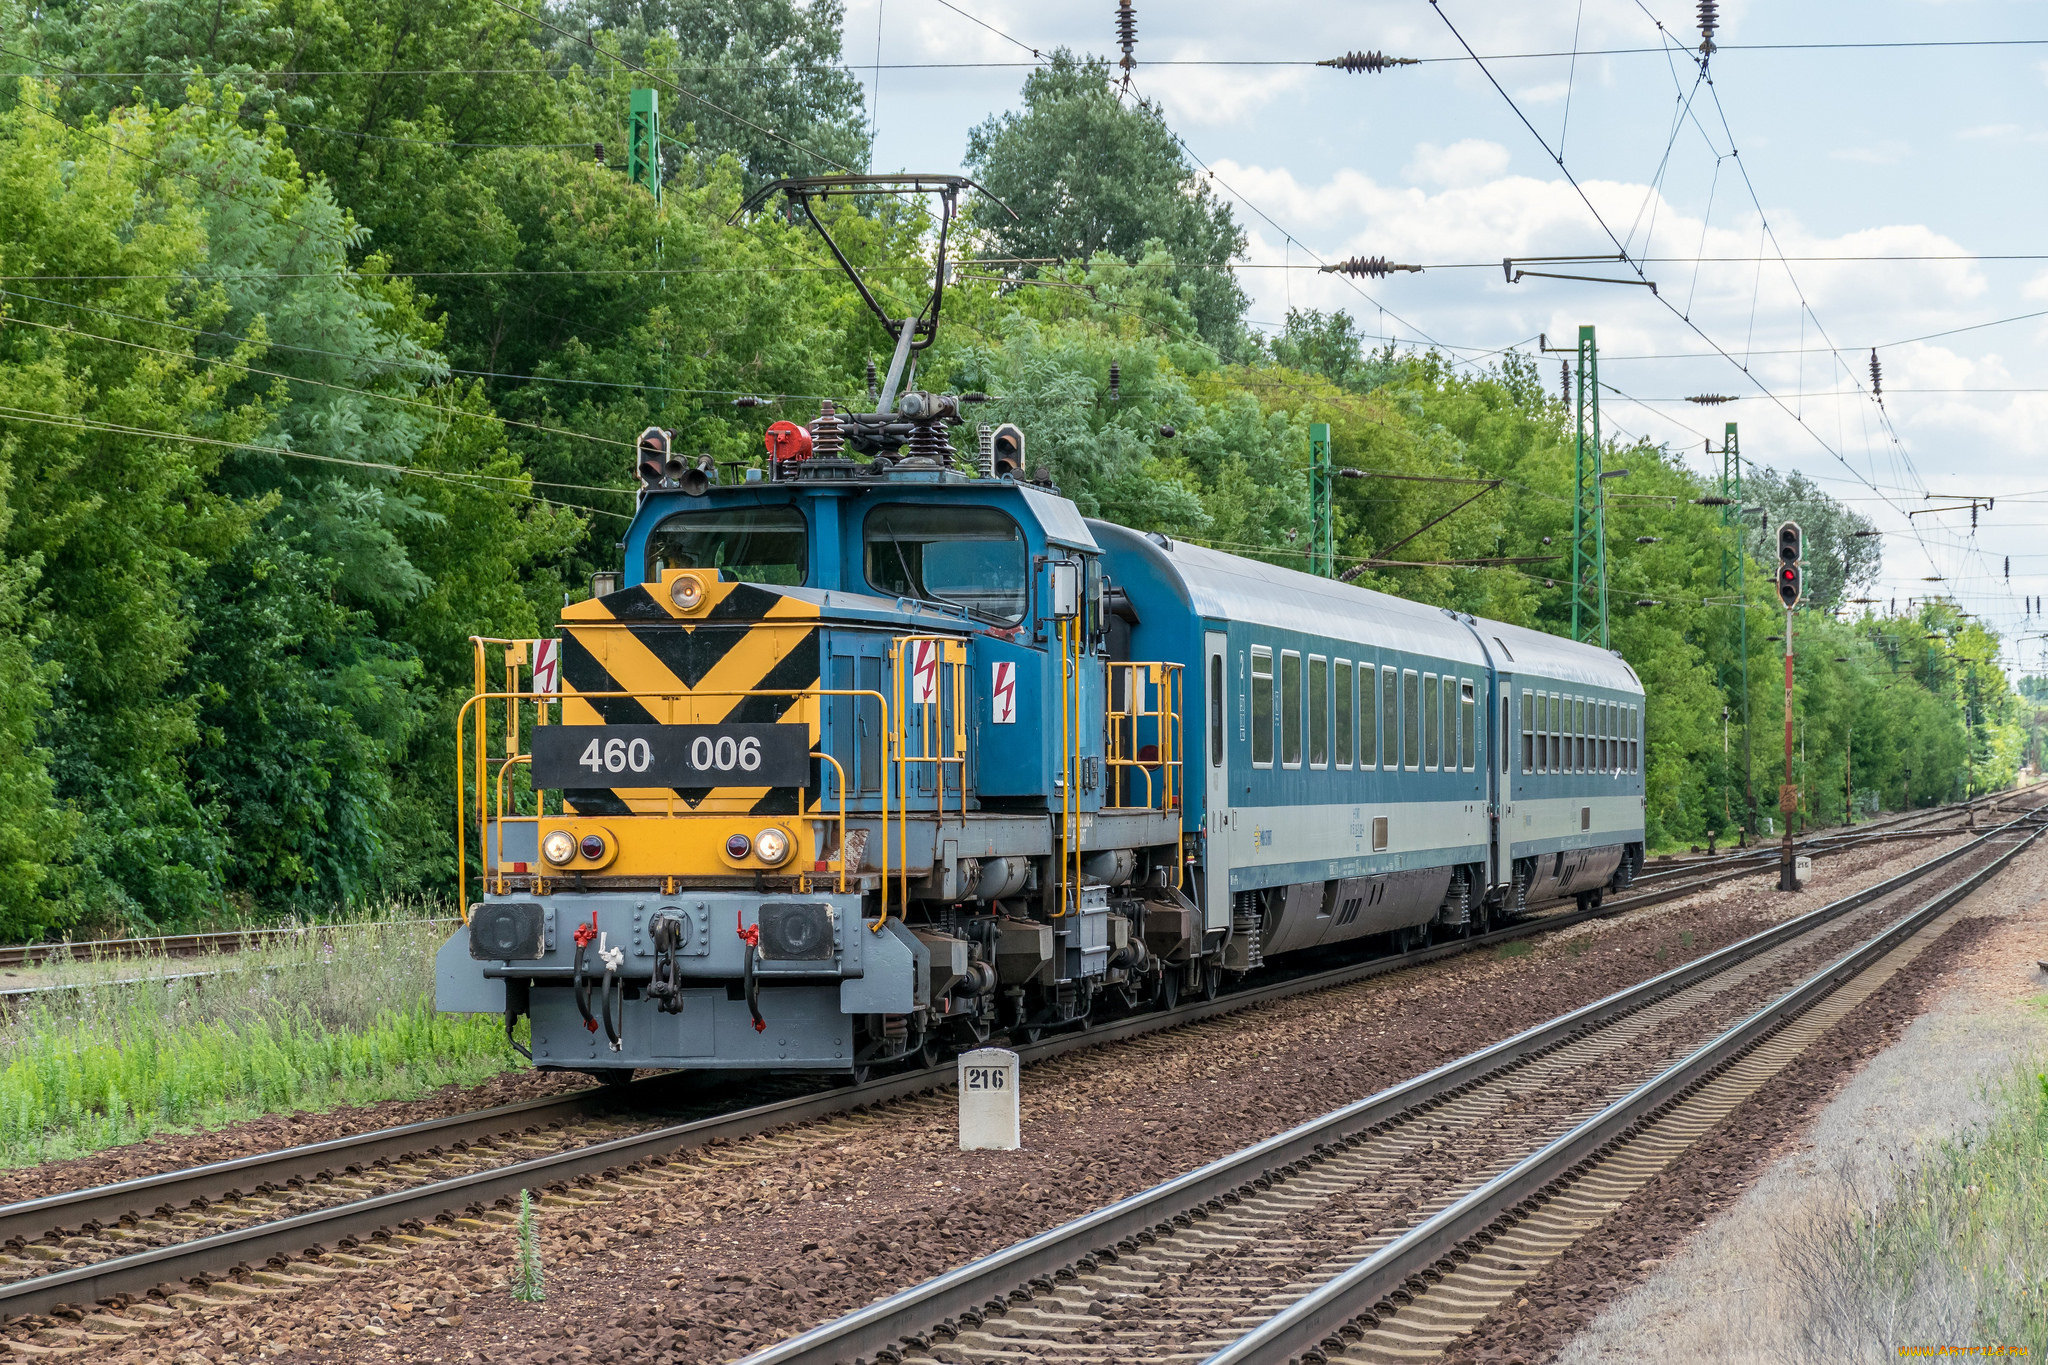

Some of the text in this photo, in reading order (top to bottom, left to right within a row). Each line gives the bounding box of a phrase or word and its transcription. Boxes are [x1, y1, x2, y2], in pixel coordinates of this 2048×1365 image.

[579, 736, 762, 773] 460 006
[969, 1069, 1004, 1089] 216
